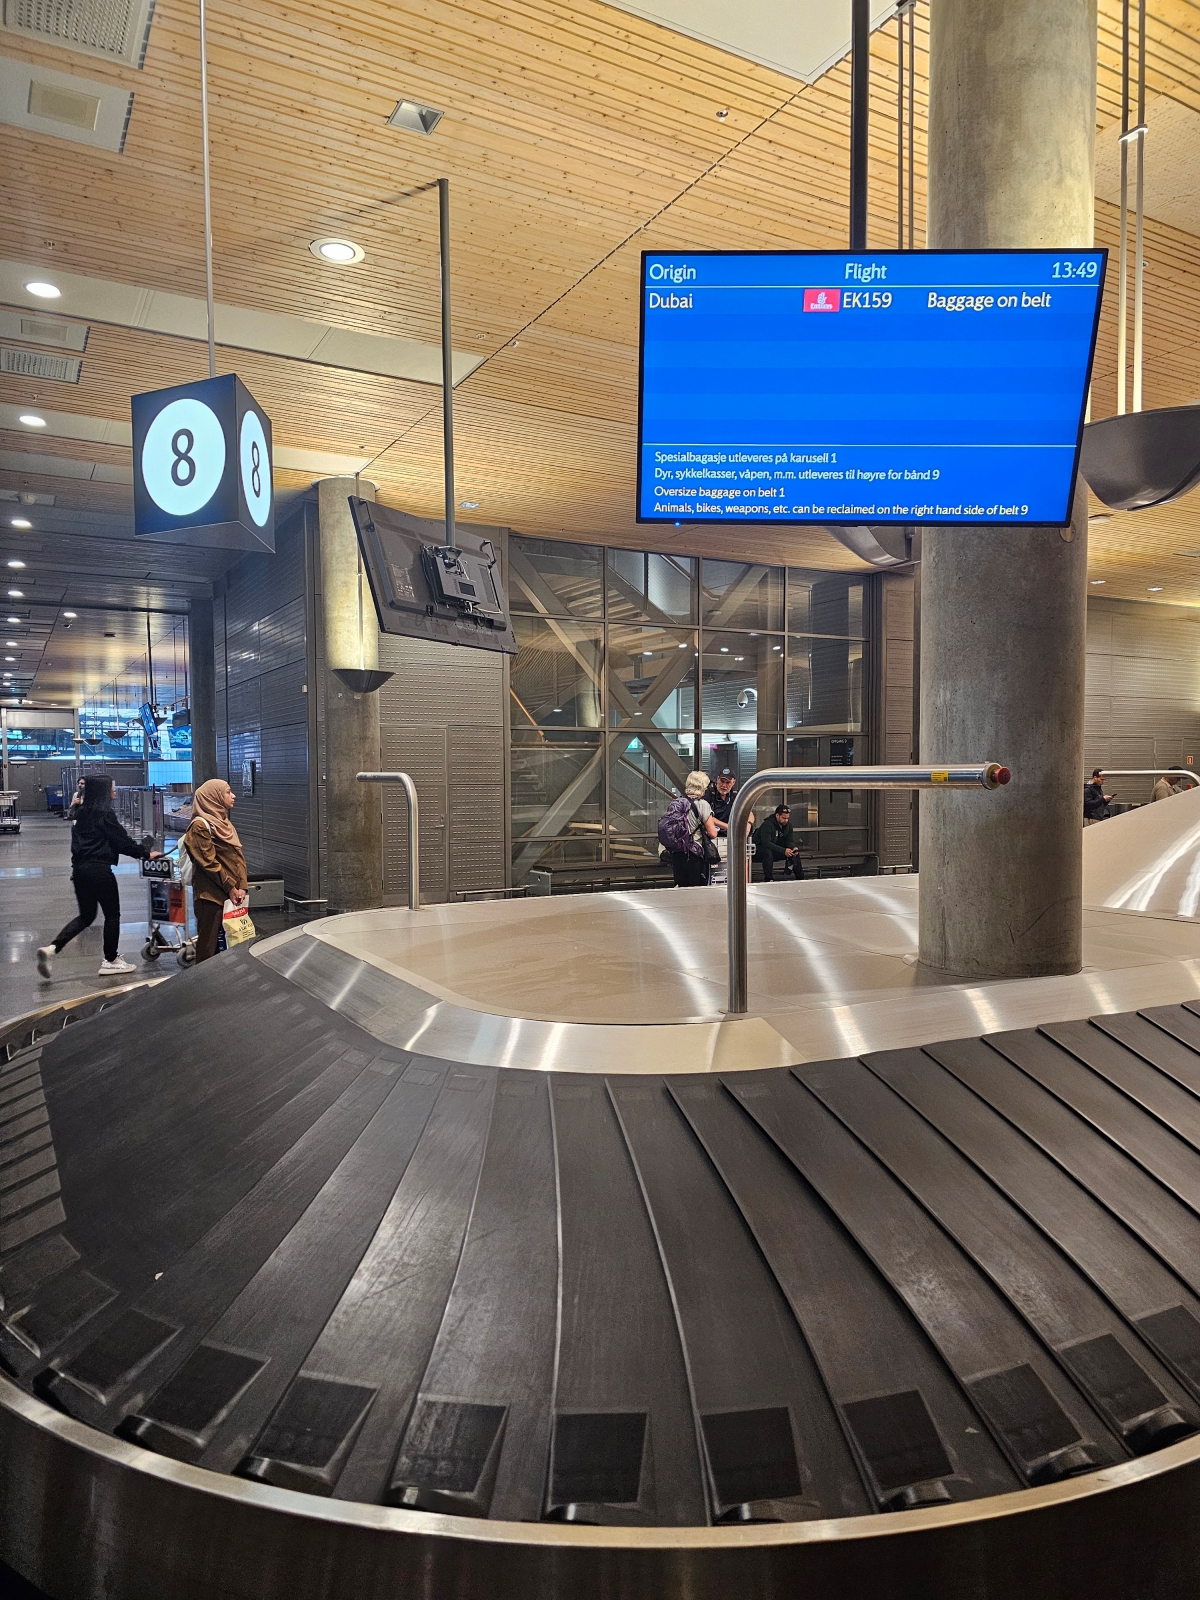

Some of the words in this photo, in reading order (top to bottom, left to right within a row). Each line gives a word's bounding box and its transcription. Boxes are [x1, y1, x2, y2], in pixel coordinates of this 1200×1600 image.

[649, 264, 697, 283] Origin
[844, 263, 888, 283] Flight
[1051, 261, 1098, 279] 13:49
[649, 293, 693, 309] Dubai
[842, 292, 893, 309] EK159
[927, 292, 994, 312] Baggage
[997, 296, 1018, 309] on
[1021, 291, 1052, 308] belt
[171, 428, 196, 487] 8
[654, 451, 727, 465] Spesialbagasje
[728, 451, 774, 464] utleveres
[774, 452, 789, 465] på
[789, 452, 829, 464] karusell
[830, 452, 838, 464] 1
[251, 440, 261, 499] 8
[654, 467, 674, 481] Dyr,
[675, 467, 738, 481] sykkelkasser,
[738, 468, 773, 481] våpen,
[773, 471, 797, 480] m.m.
[798, 468, 844, 480] utleveres
[845, 469, 856, 480] til
[856, 469, 887, 482] høyre
[887, 468, 903, 480] for
[903, 469, 931, 480] bånd
[931, 469, 940, 480] 9
[653, 485, 697, 497] Oversize
[698, 486, 741, 499] baggage
[742, 489, 757, 498] on
[757, 486, 778, 498] belt
[779, 487, 786, 498] 1
[653, 501, 695, 515] Animals,
[696, 502, 724, 515] bikes,
[724, 505, 772, 515] weapons,
[772, 504, 791, 514] etc.
[792, 505, 811, 514] can
[811, 503, 826, 514] be
[826, 503, 876, 515] reclaimed
[876, 506, 891, 515] on
[892, 504, 910, 515] the
[910, 504, 935, 517] right
[935, 504, 962, 515] hand
[962, 504, 985, 516] side
[986, 504, 999, 516] of
[999, 504, 1020, 516] belt
[1020, 504, 1029, 516] 9
